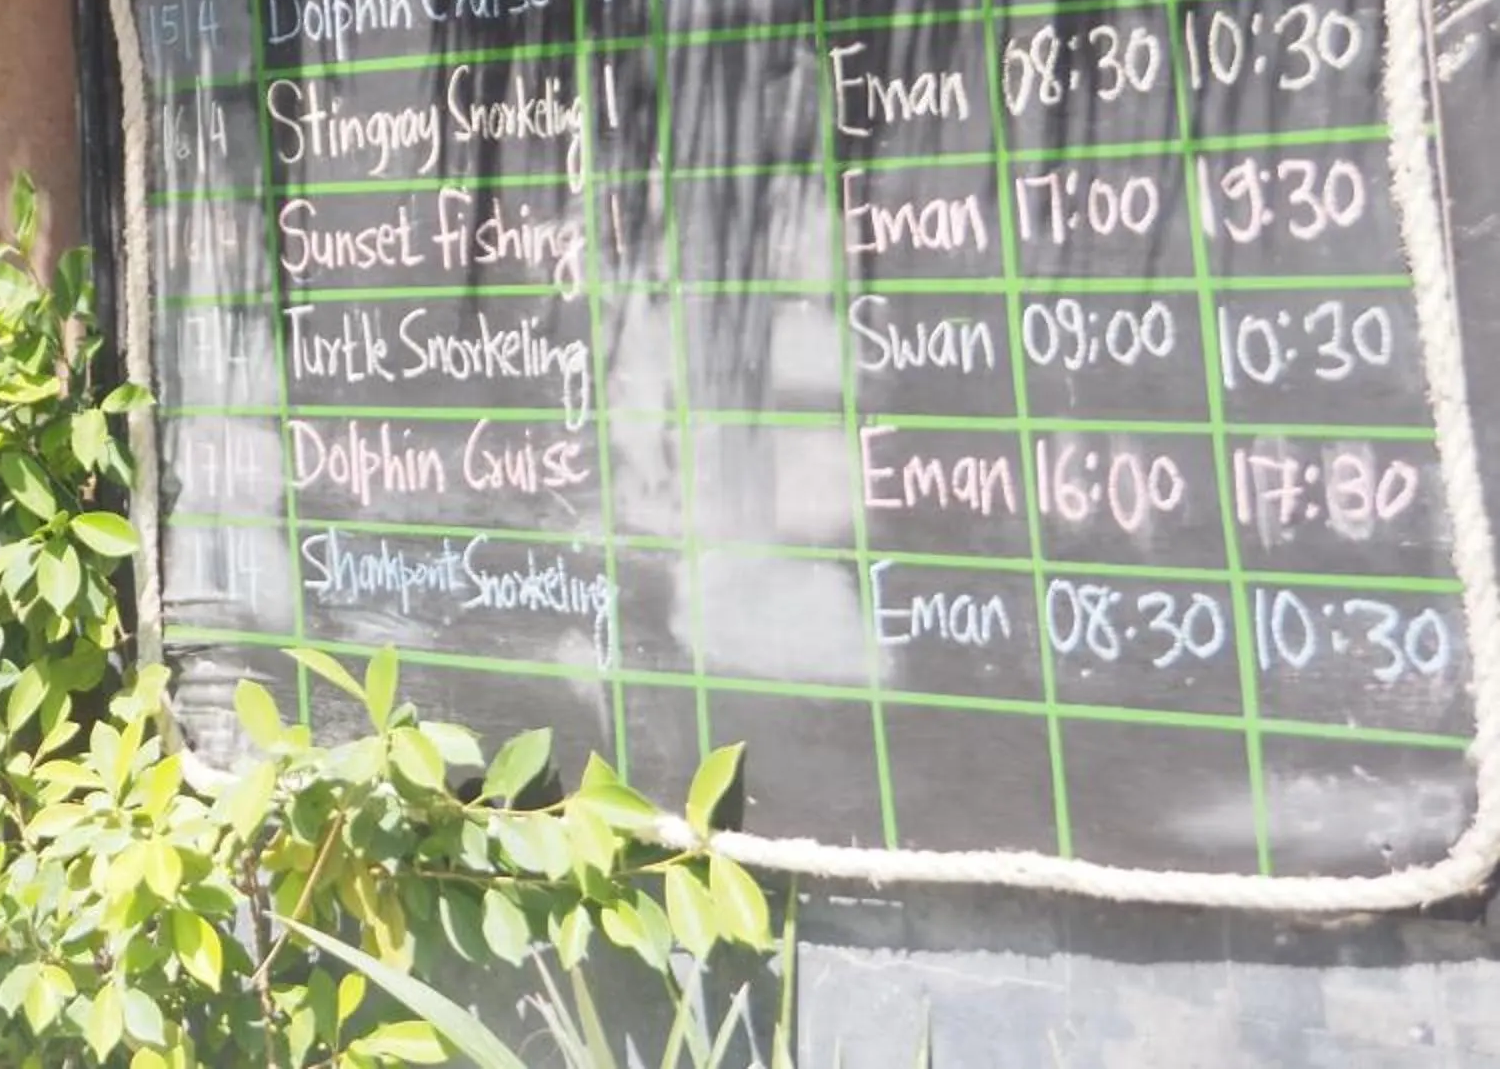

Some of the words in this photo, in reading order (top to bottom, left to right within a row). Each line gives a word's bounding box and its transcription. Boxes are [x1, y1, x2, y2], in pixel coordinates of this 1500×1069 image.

[268, 79, 440, 174] Stingray
[447, 65, 586, 194] Snorkeling
[830, 41, 970, 137] Eman
[1003, 25, 1160, 118] 08:30
[1186, 3, 1362, 90] 10:30
[278, 198, 425, 274] Sunset
[433, 186, 586, 300] fishing
[842, 167, 988, 255] Eman
[1016, 171, 1160, 246] 17:00
[1196, 155, 1366, 244] 19:30
[284, 304, 395, 383] Turtle
[400, 307, 589, 430] Snorkeling
[848, 294, 996, 374] Swan
[1023, 298, 1175, 372] 09:00
[1217, 300, 1394, 389] 10:30
[288, 418, 444, 506] Dolphin
[463, 417, 591, 491] Cruise
[861, 424, 1016, 515] Eman
[1037, 439, 1184, 532] 16:00
[1234, 449, 1417, 524] 17:30
[463, 534, 618, 671] Snorkeling
[871, 559, 1010, 646] Eman
[1256, 588, 1448, 683] 10:30
